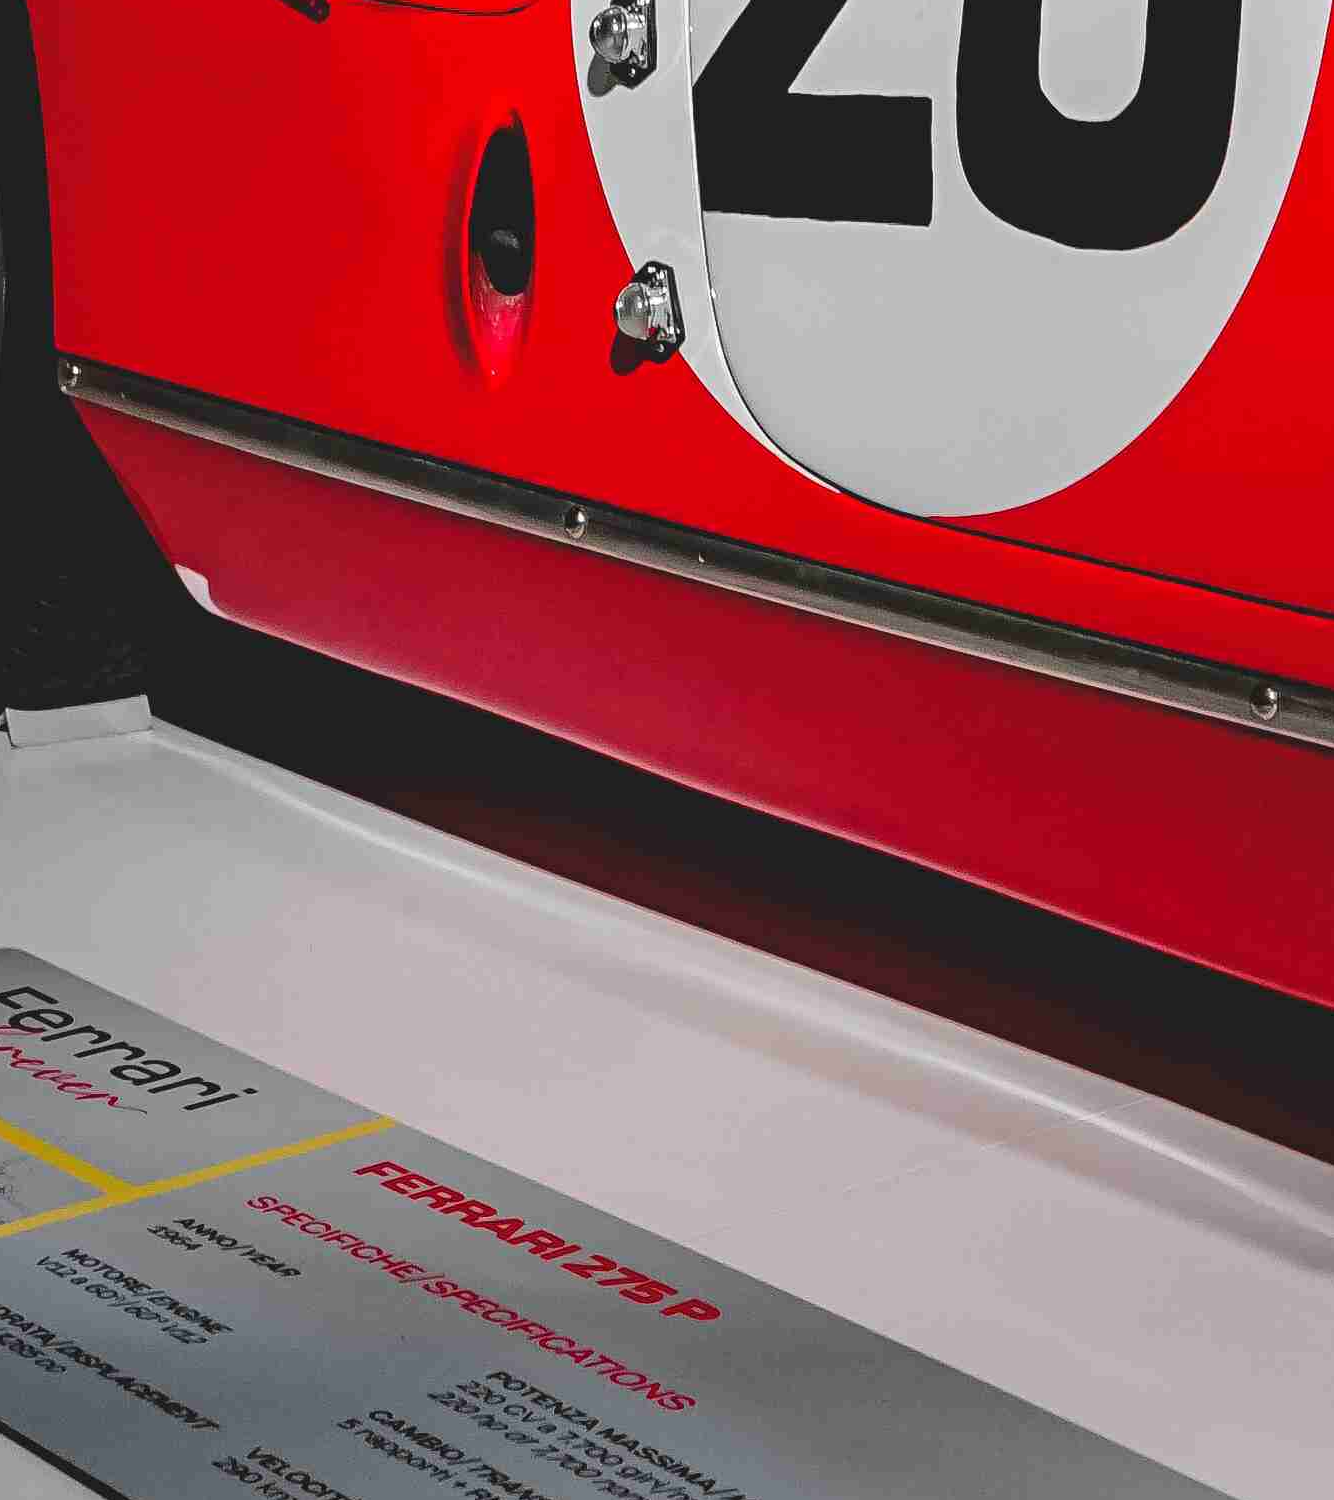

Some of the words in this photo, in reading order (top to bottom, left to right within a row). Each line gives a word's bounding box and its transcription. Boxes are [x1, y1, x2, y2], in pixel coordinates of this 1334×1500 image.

[173, 1219, 301, 1277] ANNO/YEAR
[352, 1161, 581, 1261] FERRARI
[561, 1254, 678, 1304] 275
[660, 1298, 721, 1322] P
[245, 1195, 695, 1411] SPECIFICHE/SPECIFICATIONS
[486, 1371, 599, 1432] POTENZA
